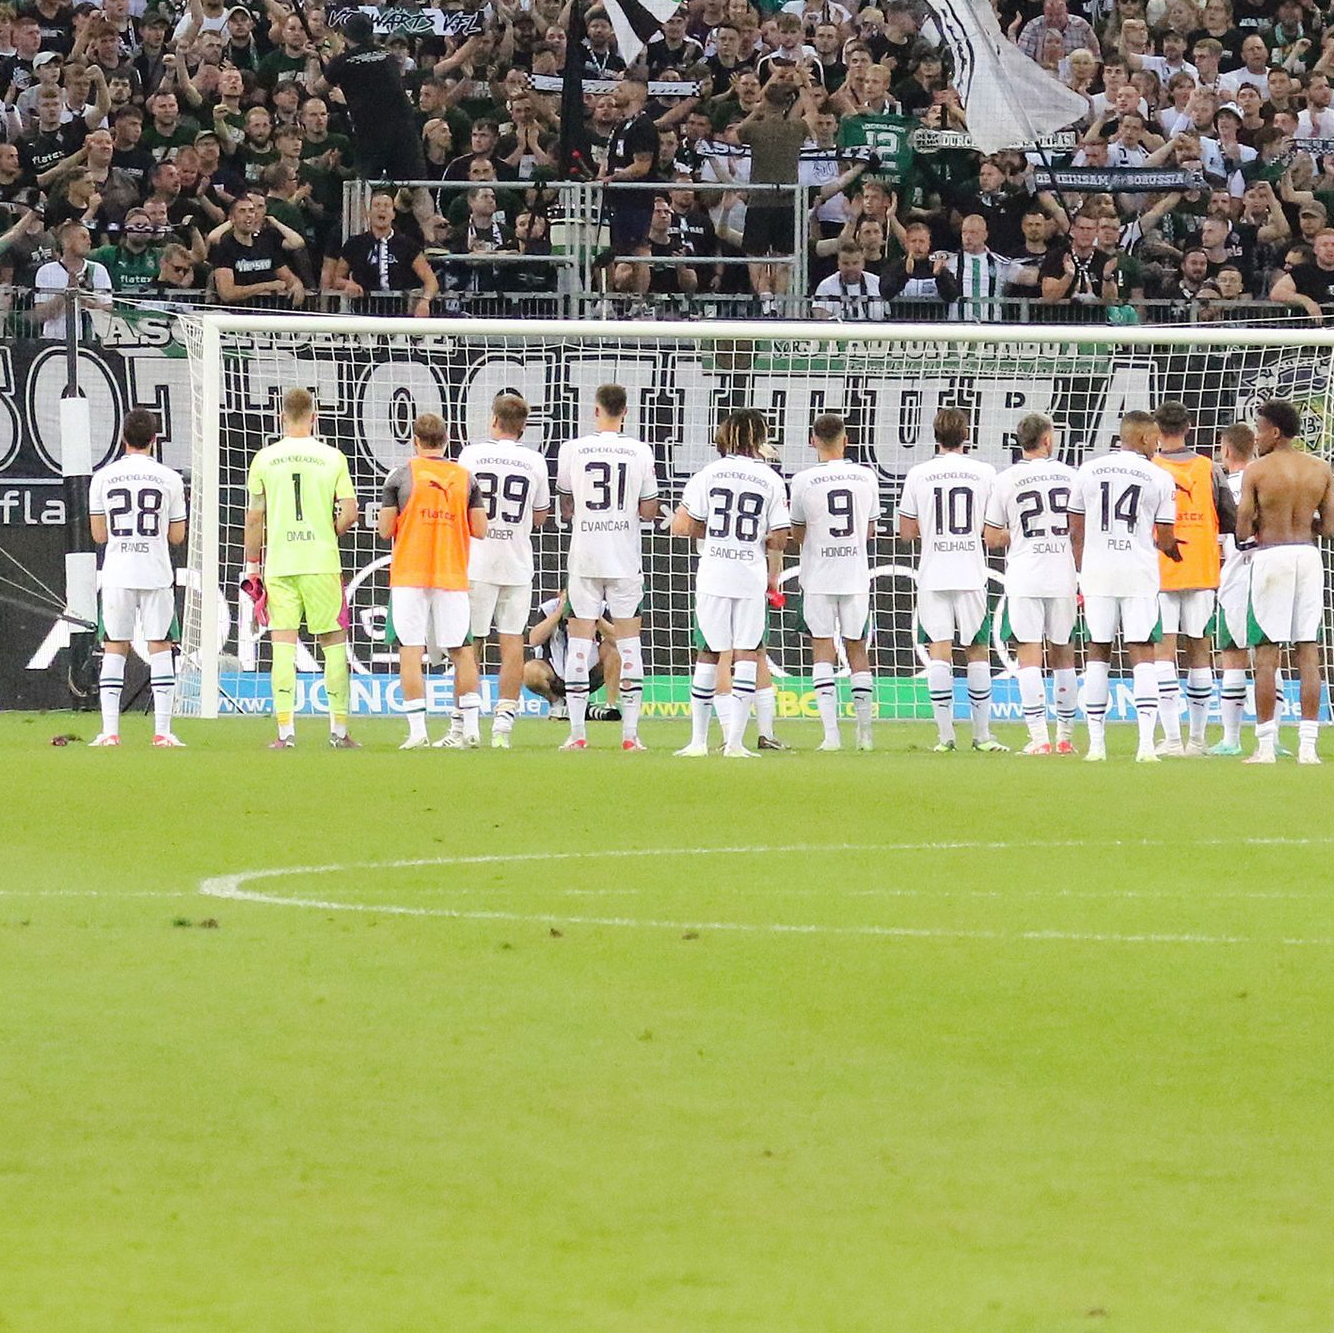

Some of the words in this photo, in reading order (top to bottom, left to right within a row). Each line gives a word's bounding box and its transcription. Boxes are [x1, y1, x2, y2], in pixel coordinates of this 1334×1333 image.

[292, 473, 304, 522] 1
[473, 472, 531, 524] 39
[585, 461, 627, 511] 31
[933, 486, 974, 536] 10
[1100, 480, 1142, 534] 14
[106, 487, 163, 537] 28
[708, 487, 765, 542] 38
[826, 488, 854, 539] 9
[1015, 487, 1072, 539] 29
[709, 546, 755, 562] SANCHES
[933, 540, 976, 552] NEUHAUS
[1032, 542, 1067, 554] SCALLY
[1107, 538, 1132, 551] PLEA
